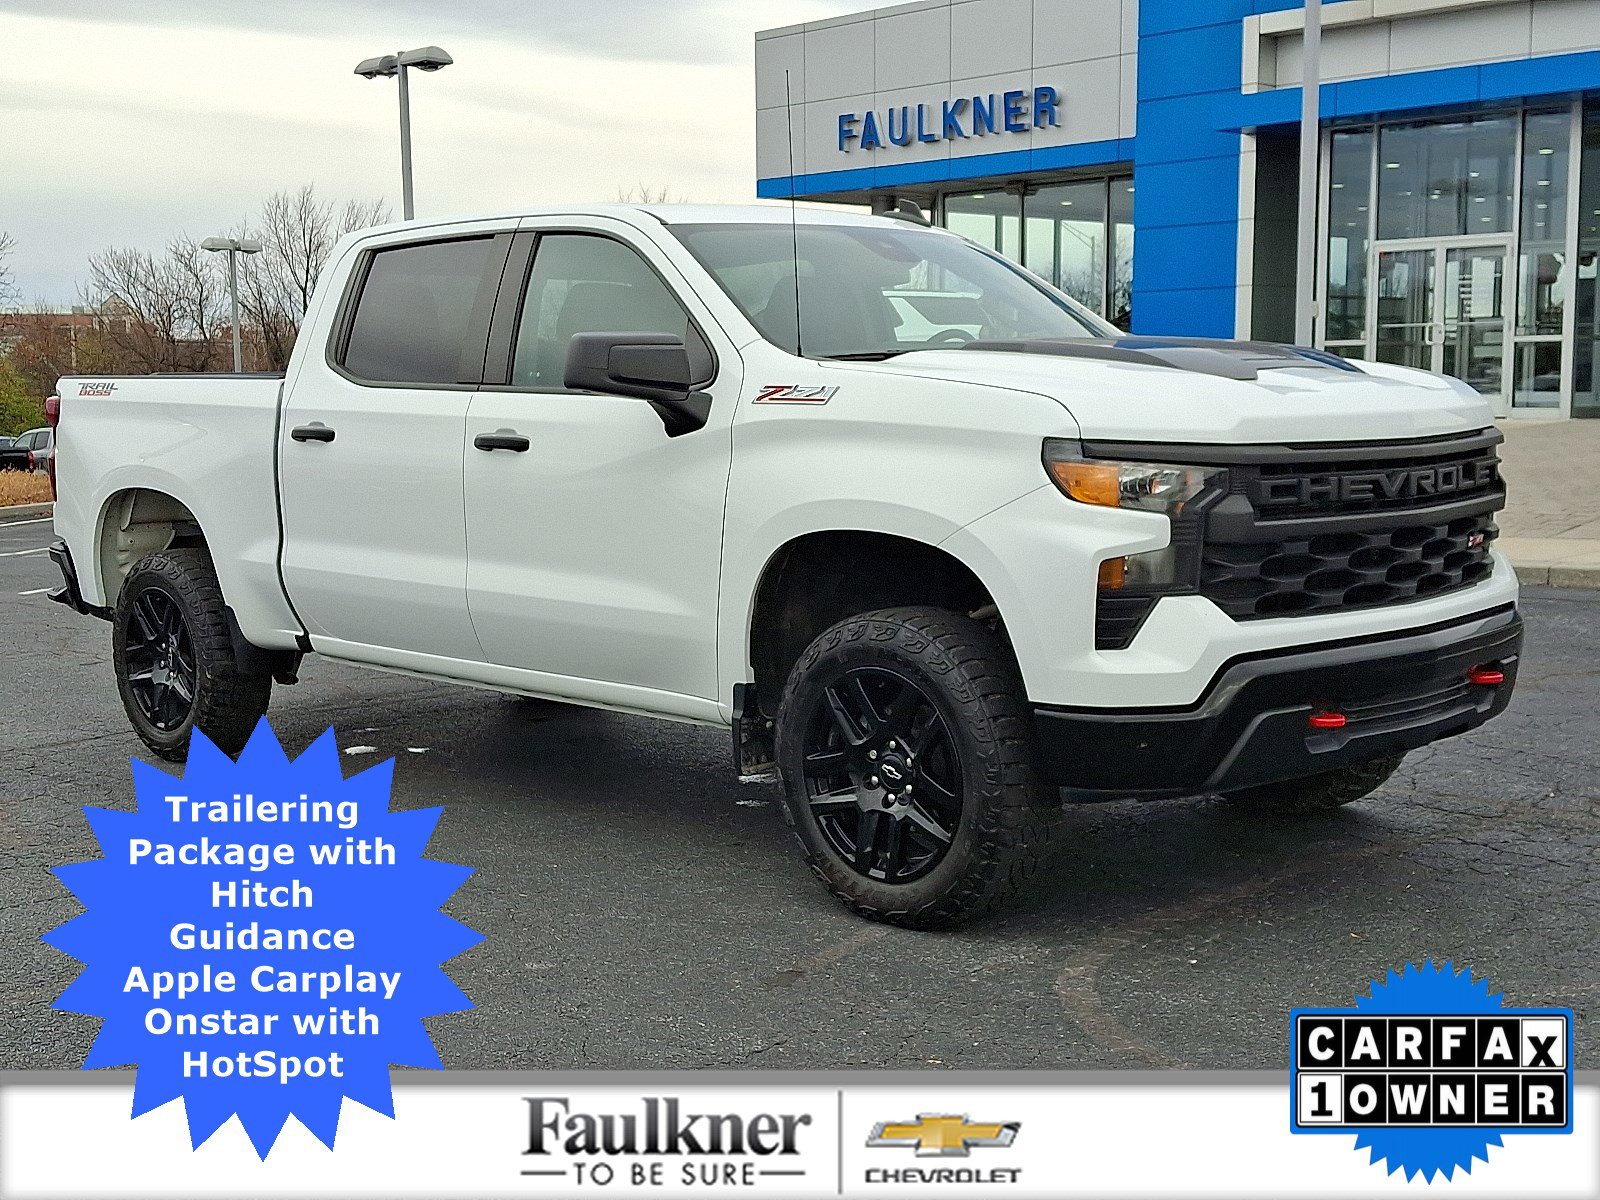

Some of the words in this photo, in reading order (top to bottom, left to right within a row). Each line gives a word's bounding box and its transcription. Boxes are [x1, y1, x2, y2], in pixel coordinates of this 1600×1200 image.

[838, 86, 1061, 152] FAULKNER
[78, 382, 118, 391] TRAIL
[78, 389, 112, 397] BOSS
